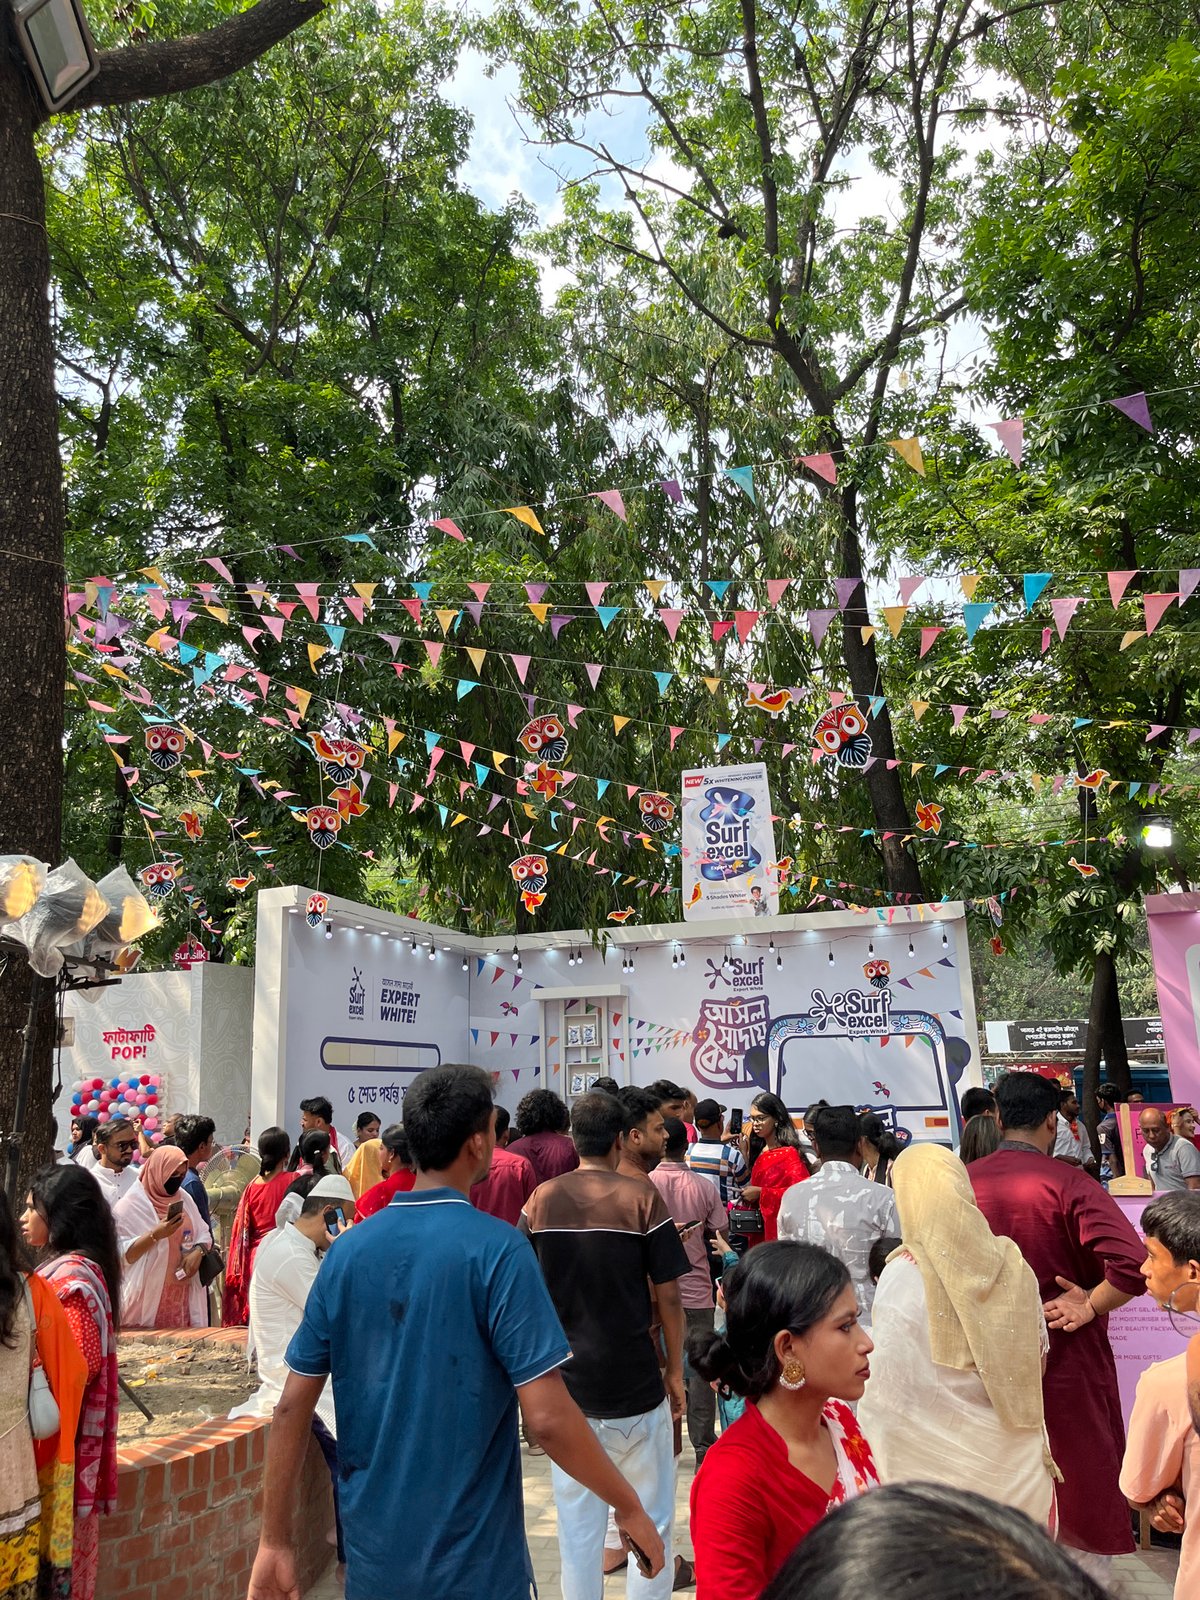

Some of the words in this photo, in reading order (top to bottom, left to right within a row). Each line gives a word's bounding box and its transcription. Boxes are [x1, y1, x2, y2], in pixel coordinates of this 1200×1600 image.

[703, 777, 714, 785] 5x
[714, 776, 743, 784] WHITENING
[706, 818, 750, 845] Surf
[706, 842, 749, 860] excel
[732, 956, 764, 976] Surf
[732, 973, 764, 987] excel
[349, 986, 365, 1004] Surf
[380, 988, 421, 1008] EXPERT
[847, 991, 888, 1014] Surf
[348, 1004, 364, 1015] excel
[380, 1005, 417, 1024] WHITE!
[703, 1000, 766, 1024] আসল
[847, 1013, 888, 1028] excel
[103, 1023, 156, 1044] ফাটাফাটি
[111, 1045, 147, 1060] POP!
[348, 1086, 355, 1103] ৫
[358, 1086, 378, 1104] শেড
[379, 1082, 400, 1105] পর্যন্ত
